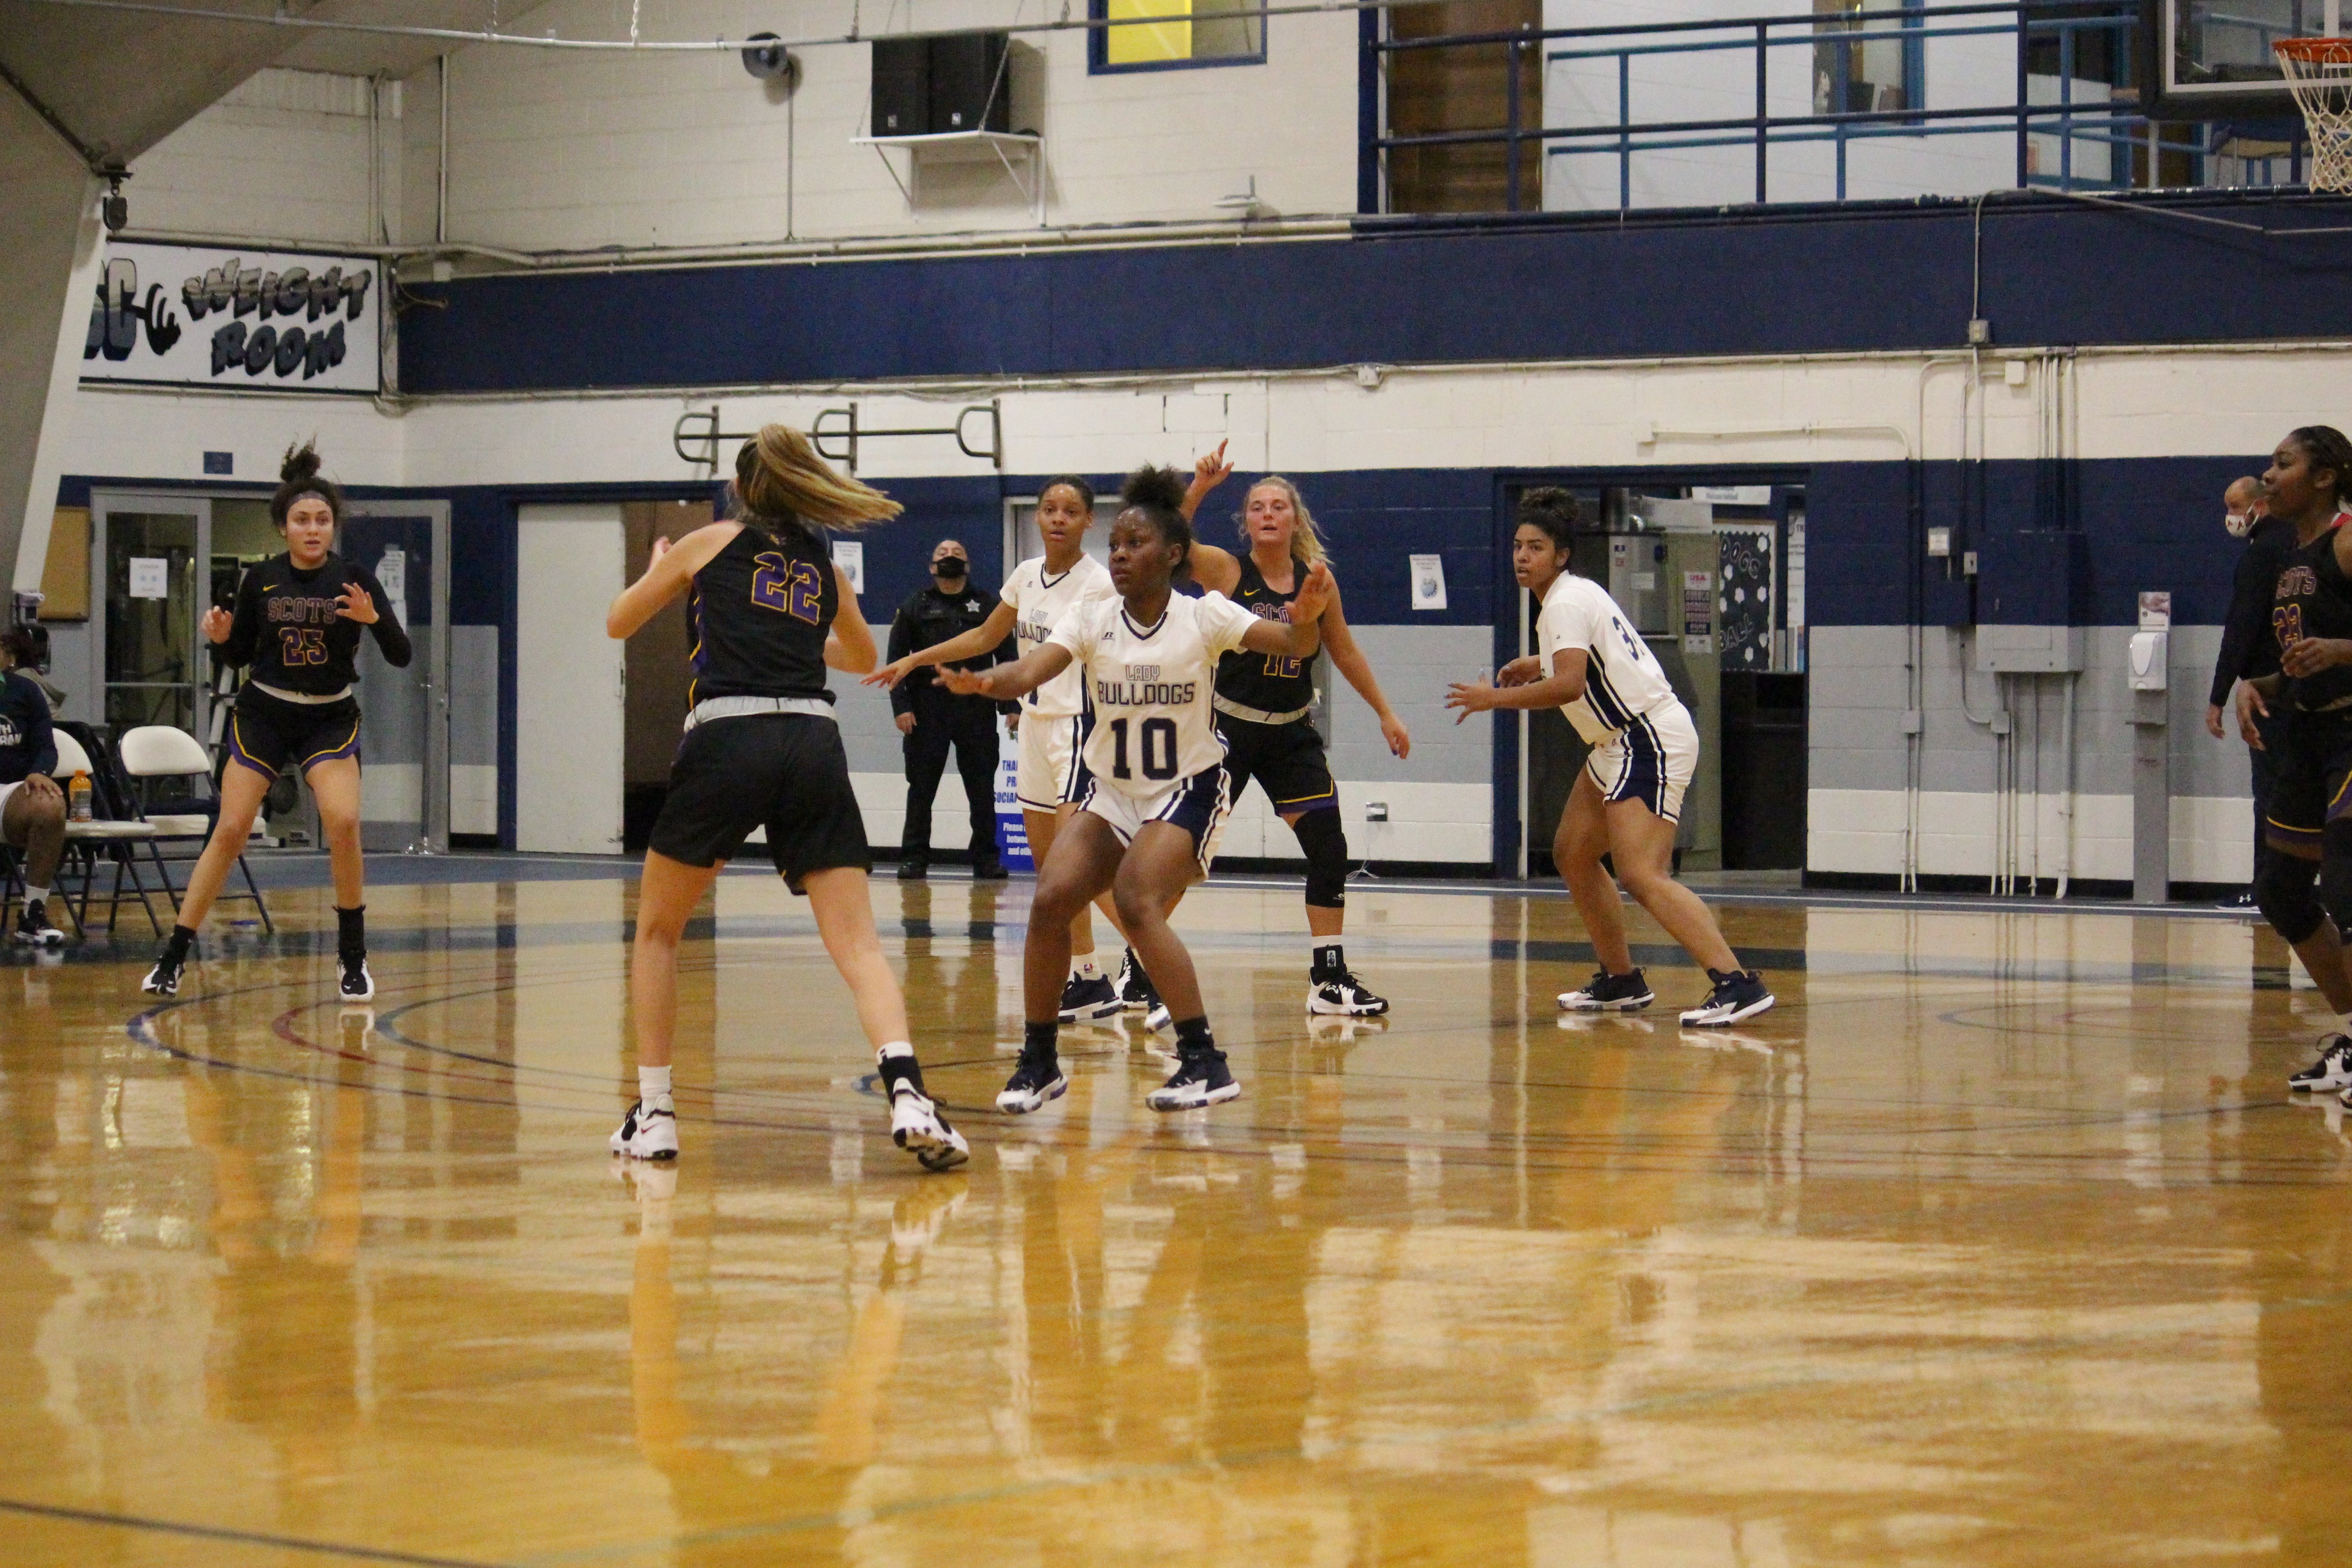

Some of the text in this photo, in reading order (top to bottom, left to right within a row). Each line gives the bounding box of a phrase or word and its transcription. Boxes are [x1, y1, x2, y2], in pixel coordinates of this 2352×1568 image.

[182, 257, 371, 323] WEIGHT
[211, 319, 346, 380] ROOM
[268, 597, 337, 624] SCOTS
[751, 551, 822, 626] 22
[279, 627, 328, 666] 25
[1098, 680, 1196, 706] BULLDOGS
[1126, 665, 1160, 681] LADY
[1110, 717, 1178, 780] 10
